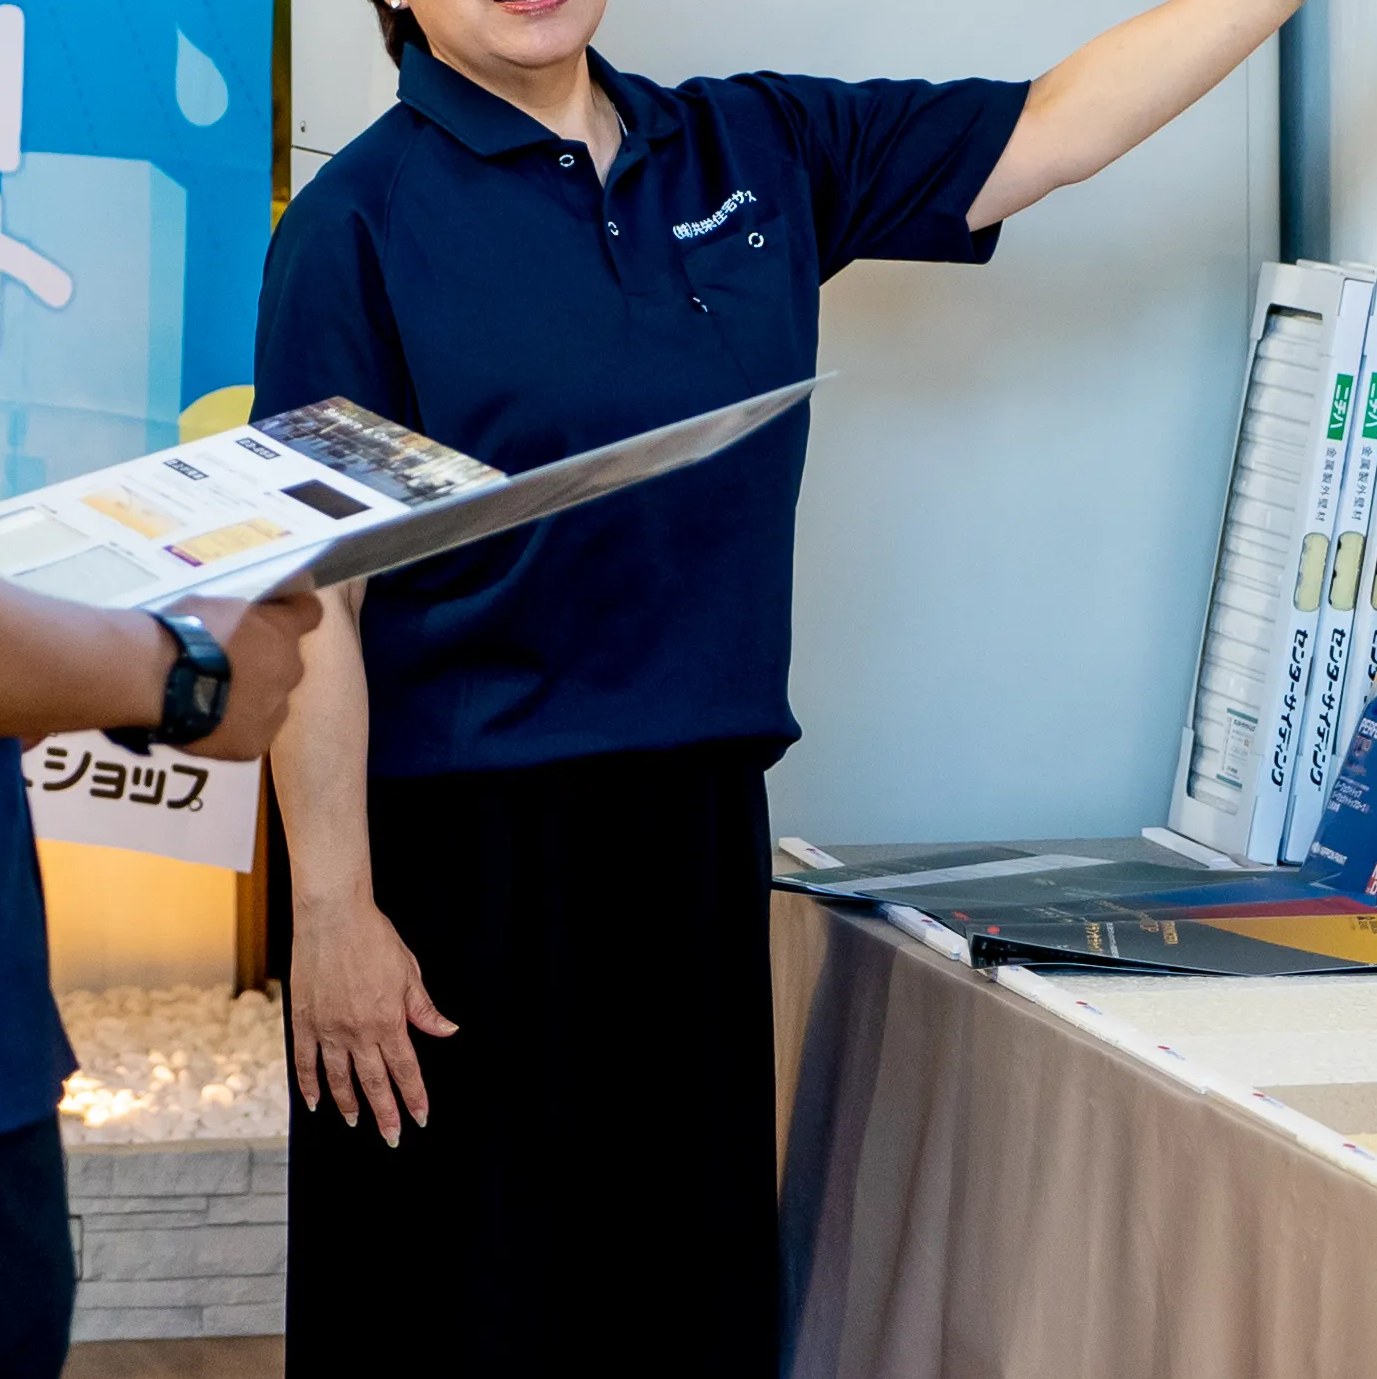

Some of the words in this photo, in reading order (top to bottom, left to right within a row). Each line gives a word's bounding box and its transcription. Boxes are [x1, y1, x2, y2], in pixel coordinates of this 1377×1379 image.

[1330, 384, 1350, 429] ニチハ
[1271, 628, 1309, 791] センターサイディング
[1310, 627, 1346, 790] センターサイディング
